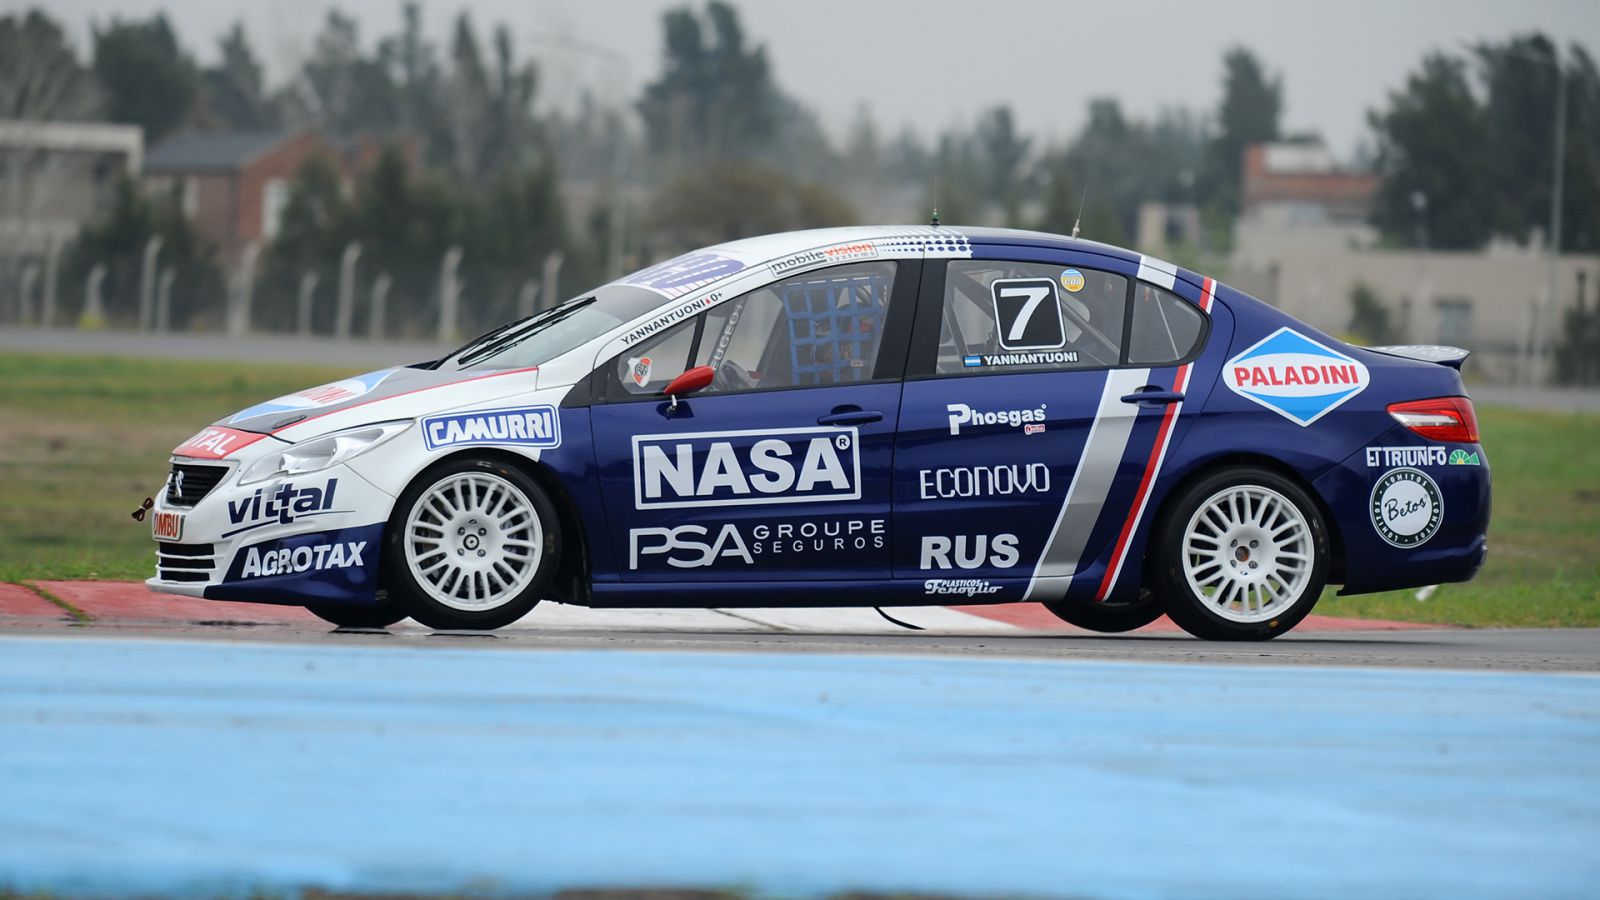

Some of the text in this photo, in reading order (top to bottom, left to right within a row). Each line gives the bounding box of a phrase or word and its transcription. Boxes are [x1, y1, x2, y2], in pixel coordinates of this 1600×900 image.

[621, 299, 706, 345] YANNANTUONI
[1000, 287, 1050, 341] 7
[984, 352, 1078, 366] YANNANTUONI
[1234, 365, 1359, 387] PALADINI
[429, 412, 553, 446] CAMURRI
[947, 403, 1046, 435] Phosgas
[642, 437, 851, 498] NASA
[1382, 446, 1447, 467] TRIUNFO
[919, 463, 1050, 499] ECONOVO
[1385, 473, 1427, 487] LOMITOS
[228, 478, 338, 525] vittal
[1384, 498, 1427, 522] Betos
[1374, 501, 1398, 542] LOMITOS
[1414, 501, 1440, 542] LOMITOS
[241, 541, 367, 579] AGROTAX
[629, 519, 885, 570] PSA GROUPE
[753, 536, 884, 555] SEGUROS
[919, 533, 1020, 570] RUS
[924, 579, 1003, 597] Fenoglio
[941, 579, 981, 587] PLASTICOS
